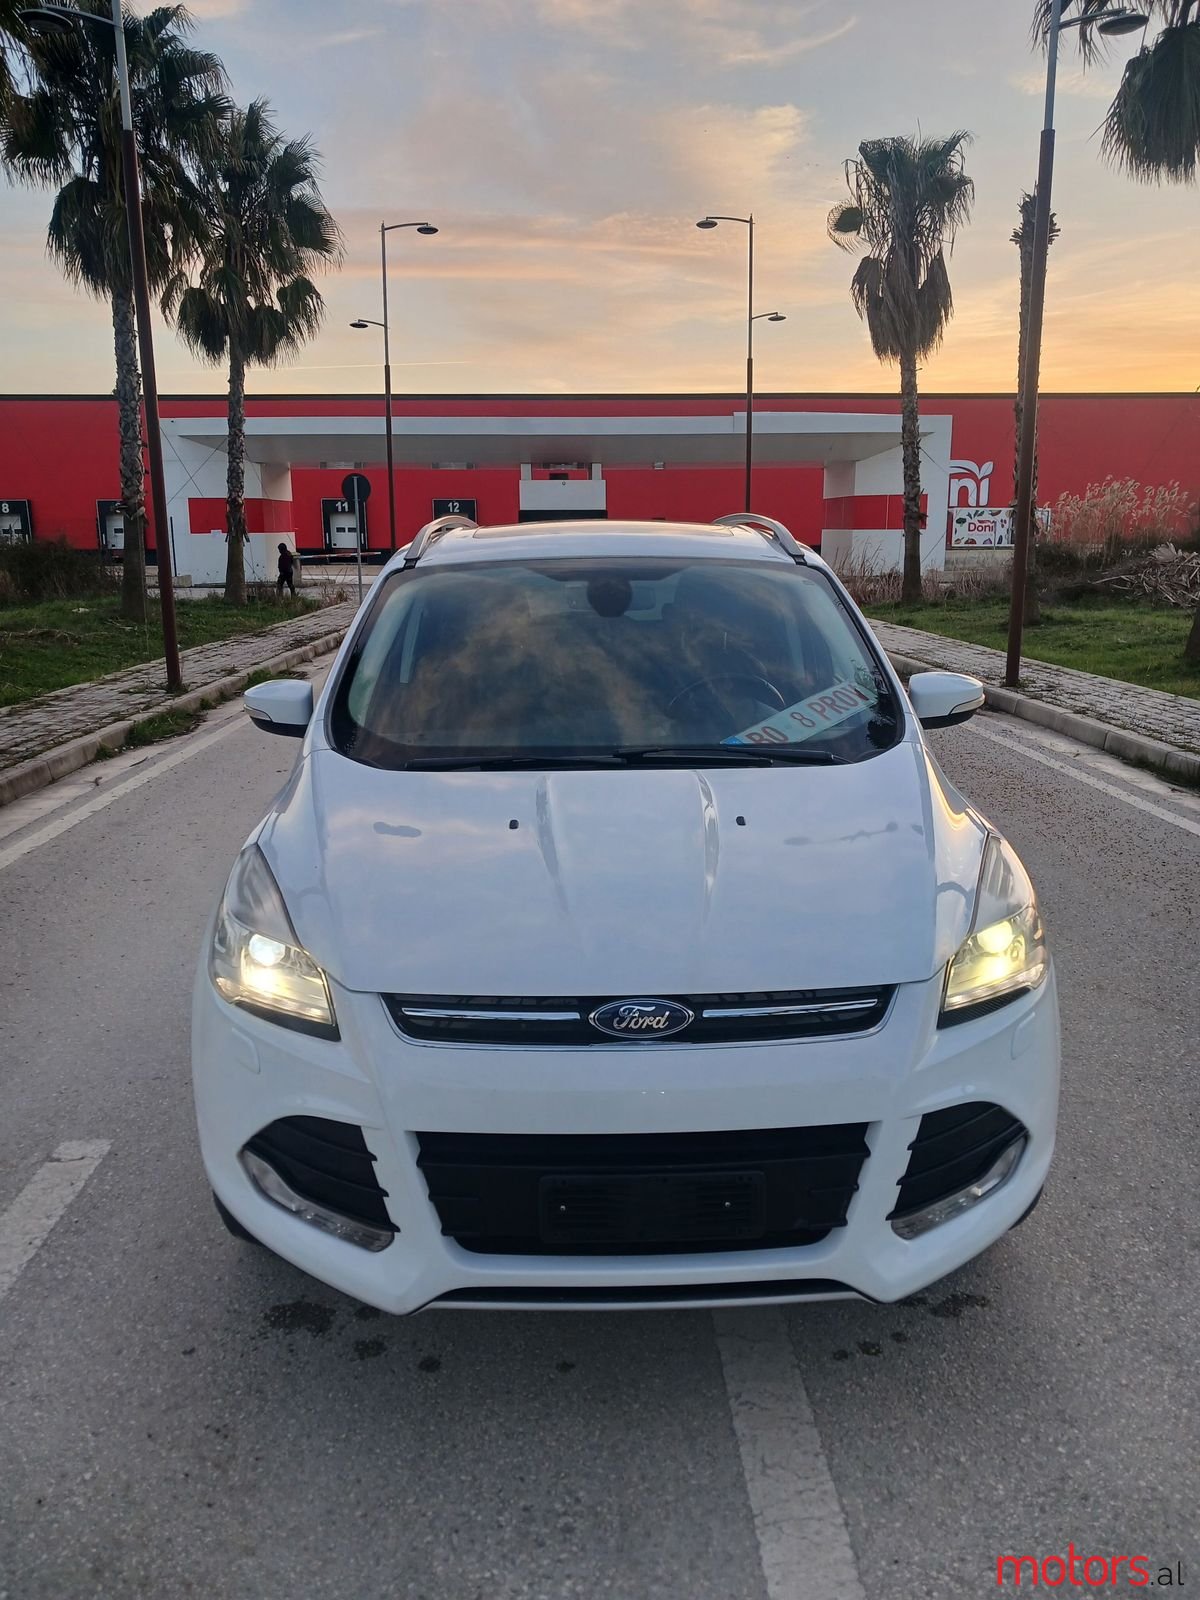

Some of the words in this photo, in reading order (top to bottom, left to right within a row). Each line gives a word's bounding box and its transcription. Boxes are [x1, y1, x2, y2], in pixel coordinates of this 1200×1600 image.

[1, 502, 10, 514] 8
[335, 501, 349, 512] 11
[447, 502, 460, 513] 12
[967, 521, 994, 532] Doni
[790, 711, 817, 728] 8
[613, 1005, 670, 1029] Ford
